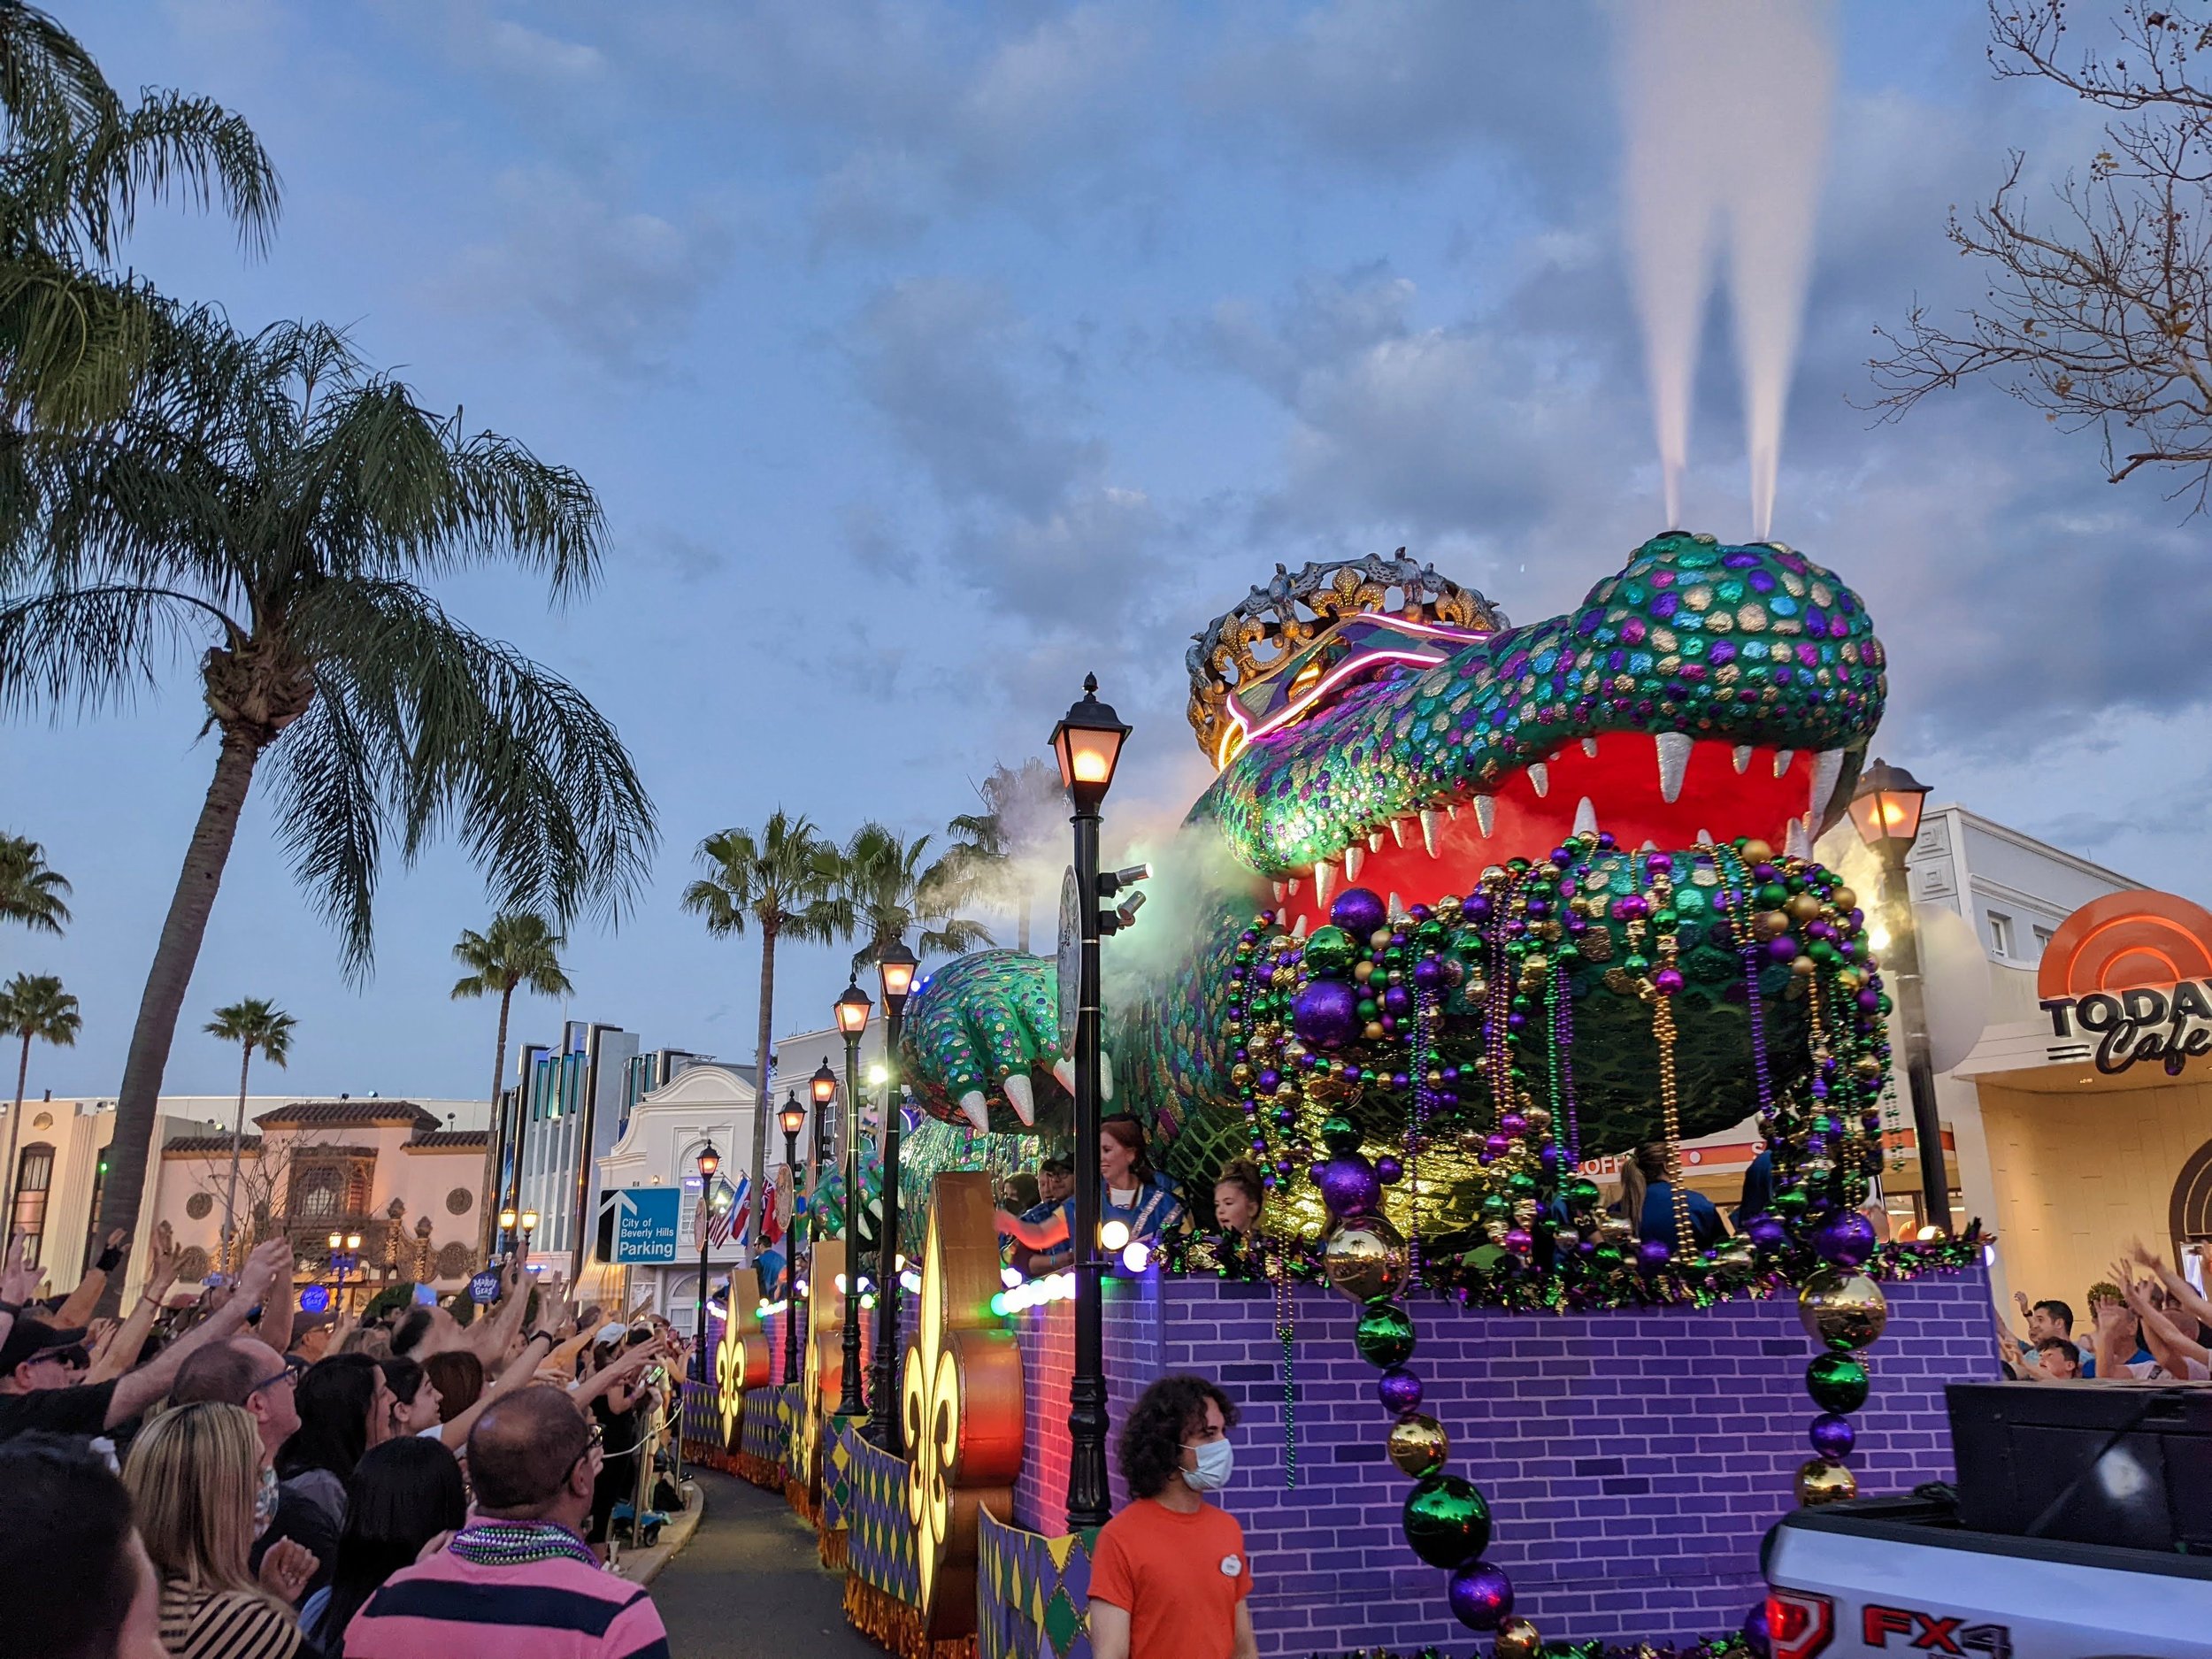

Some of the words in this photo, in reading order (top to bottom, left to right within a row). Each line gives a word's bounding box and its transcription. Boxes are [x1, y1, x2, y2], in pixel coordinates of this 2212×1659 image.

[2039, 979, 2212, 1037] TODA
[622, 1218, 639, 1230] City
[642, 1217, 652, 1227] of
[621, 1228, 653, 1239] Beverly
[656, 1227, 674, 1237] Hills
[619, 1240, 673, 1257] Parking
[1863, 1604, 2012, 1659] FX4
